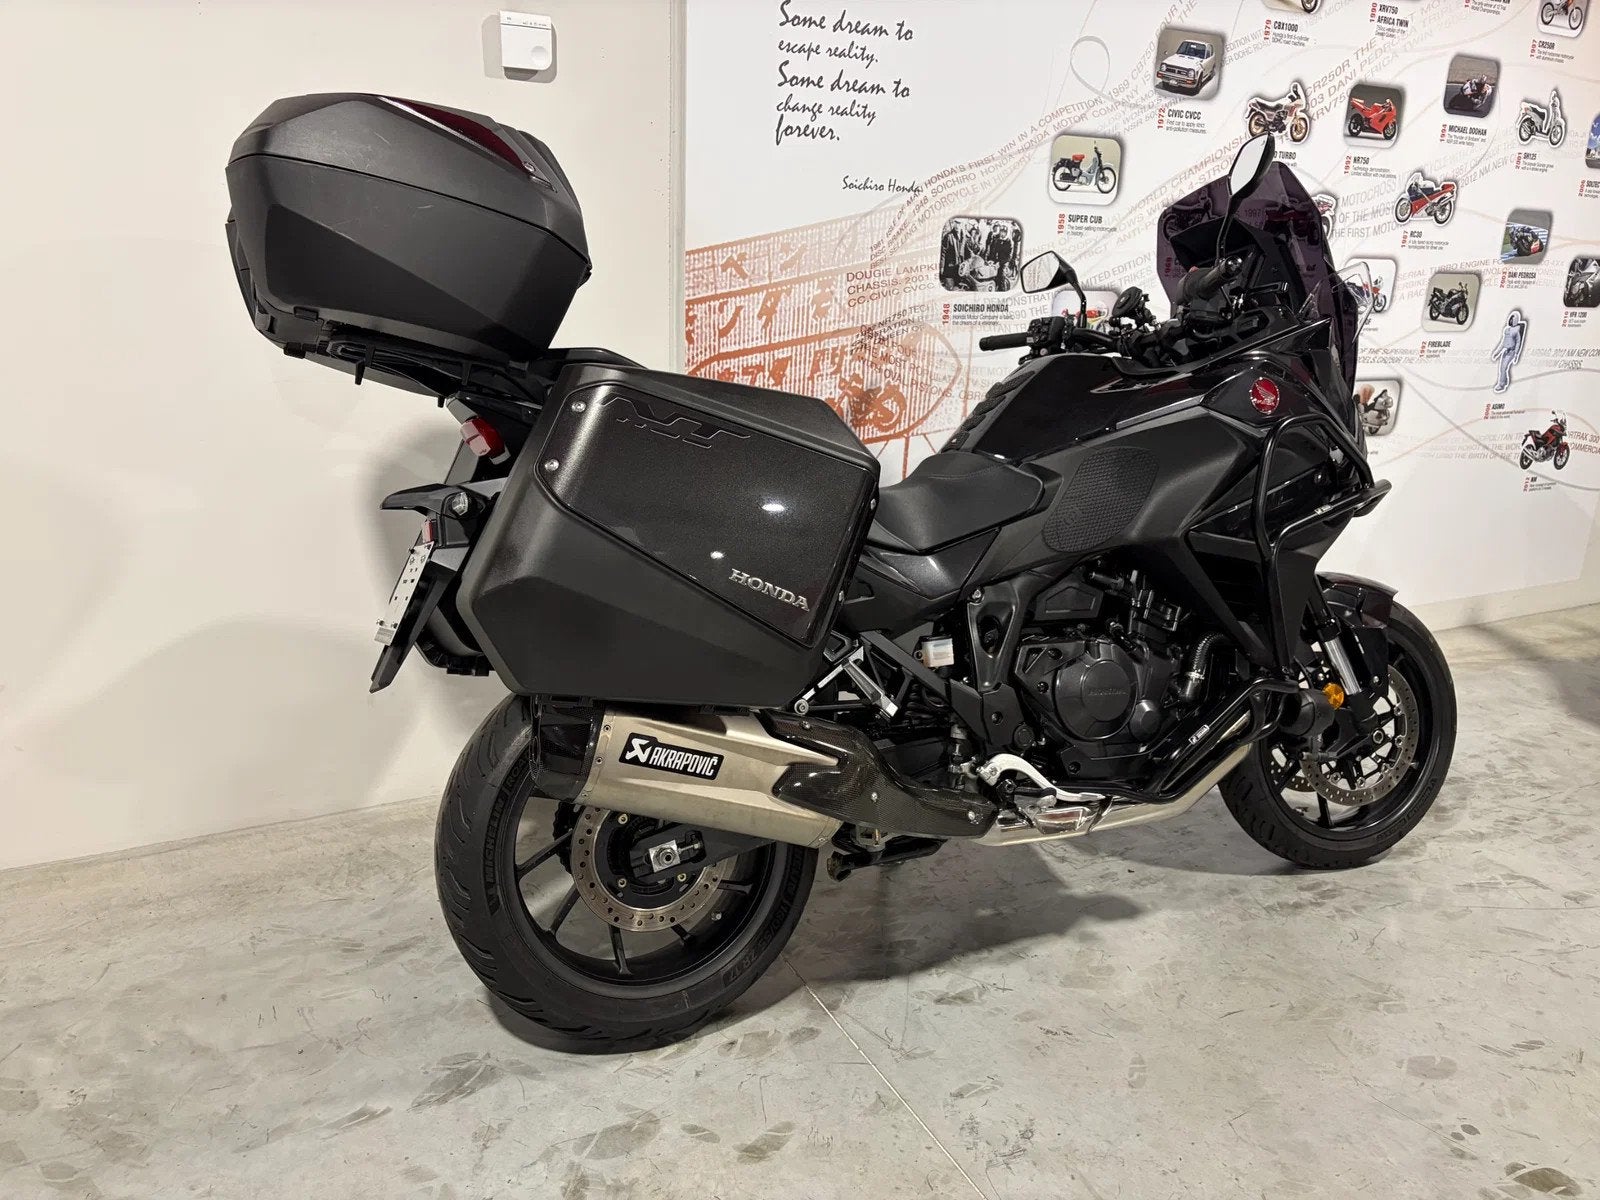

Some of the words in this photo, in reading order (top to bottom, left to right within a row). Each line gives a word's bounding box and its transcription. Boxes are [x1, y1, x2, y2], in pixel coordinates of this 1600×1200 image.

[778, 0, 826, 29] Some
[833, 10, 889, 37] dream
[895, 20, 914, 41] to
[1273, 20, 1299, 33] CBX1000
[1377, 15, 1395, 26] AFRICA
[778, 39, 821, 61] escape
[826, 41, 879, 69] reality.
[777, 60, 824, 89] Some
[830, 69, 886, 95] dream
[892, 78, 910, 98] to
[776, 93, 823, 122] change
[828, 99, 876, 126] reality
[1167, 109, 1184, 118] CIVIC
[1185, 110, 1202, 120] CVCC
[776, 113, 840, 146] forever.
[1449, 124, 1468, 134] MICHAEL
[924, 164, 966, 188] HONDA'S
[968, 155, 995, 170] FIRST
[998, 141, 1016, 157] WIN
[1017, 131, 1028, 142] IN
[1030, 125, 1038, 134] A
[931, 173, 976, 198] SOICHIRO
[1053, 113, 1088, 132] MOTOR
[1171, 132, 1250, 188] CHAMPIONSHI
[842, 175, 884, 191] Soichiro
[888, 178, 920, 193] Honda
[917, 183, 980, 227] MOTORCYCLE
[1068, 214, 1088, 223] SUPER
[1090, 215, 1103, 224] CUB
[846, 267, 892, 283] DOUGIE
[896, 263, 940, 276] LAMPKI
[903, 281, 935, 295] CVCC
[942, 304, 951, 326] 1948
[953, 304, 985, 312] SOICHIRO
[986, 304, 1009, 313] HONDA
[728, 568, 809, 612] HONDA
